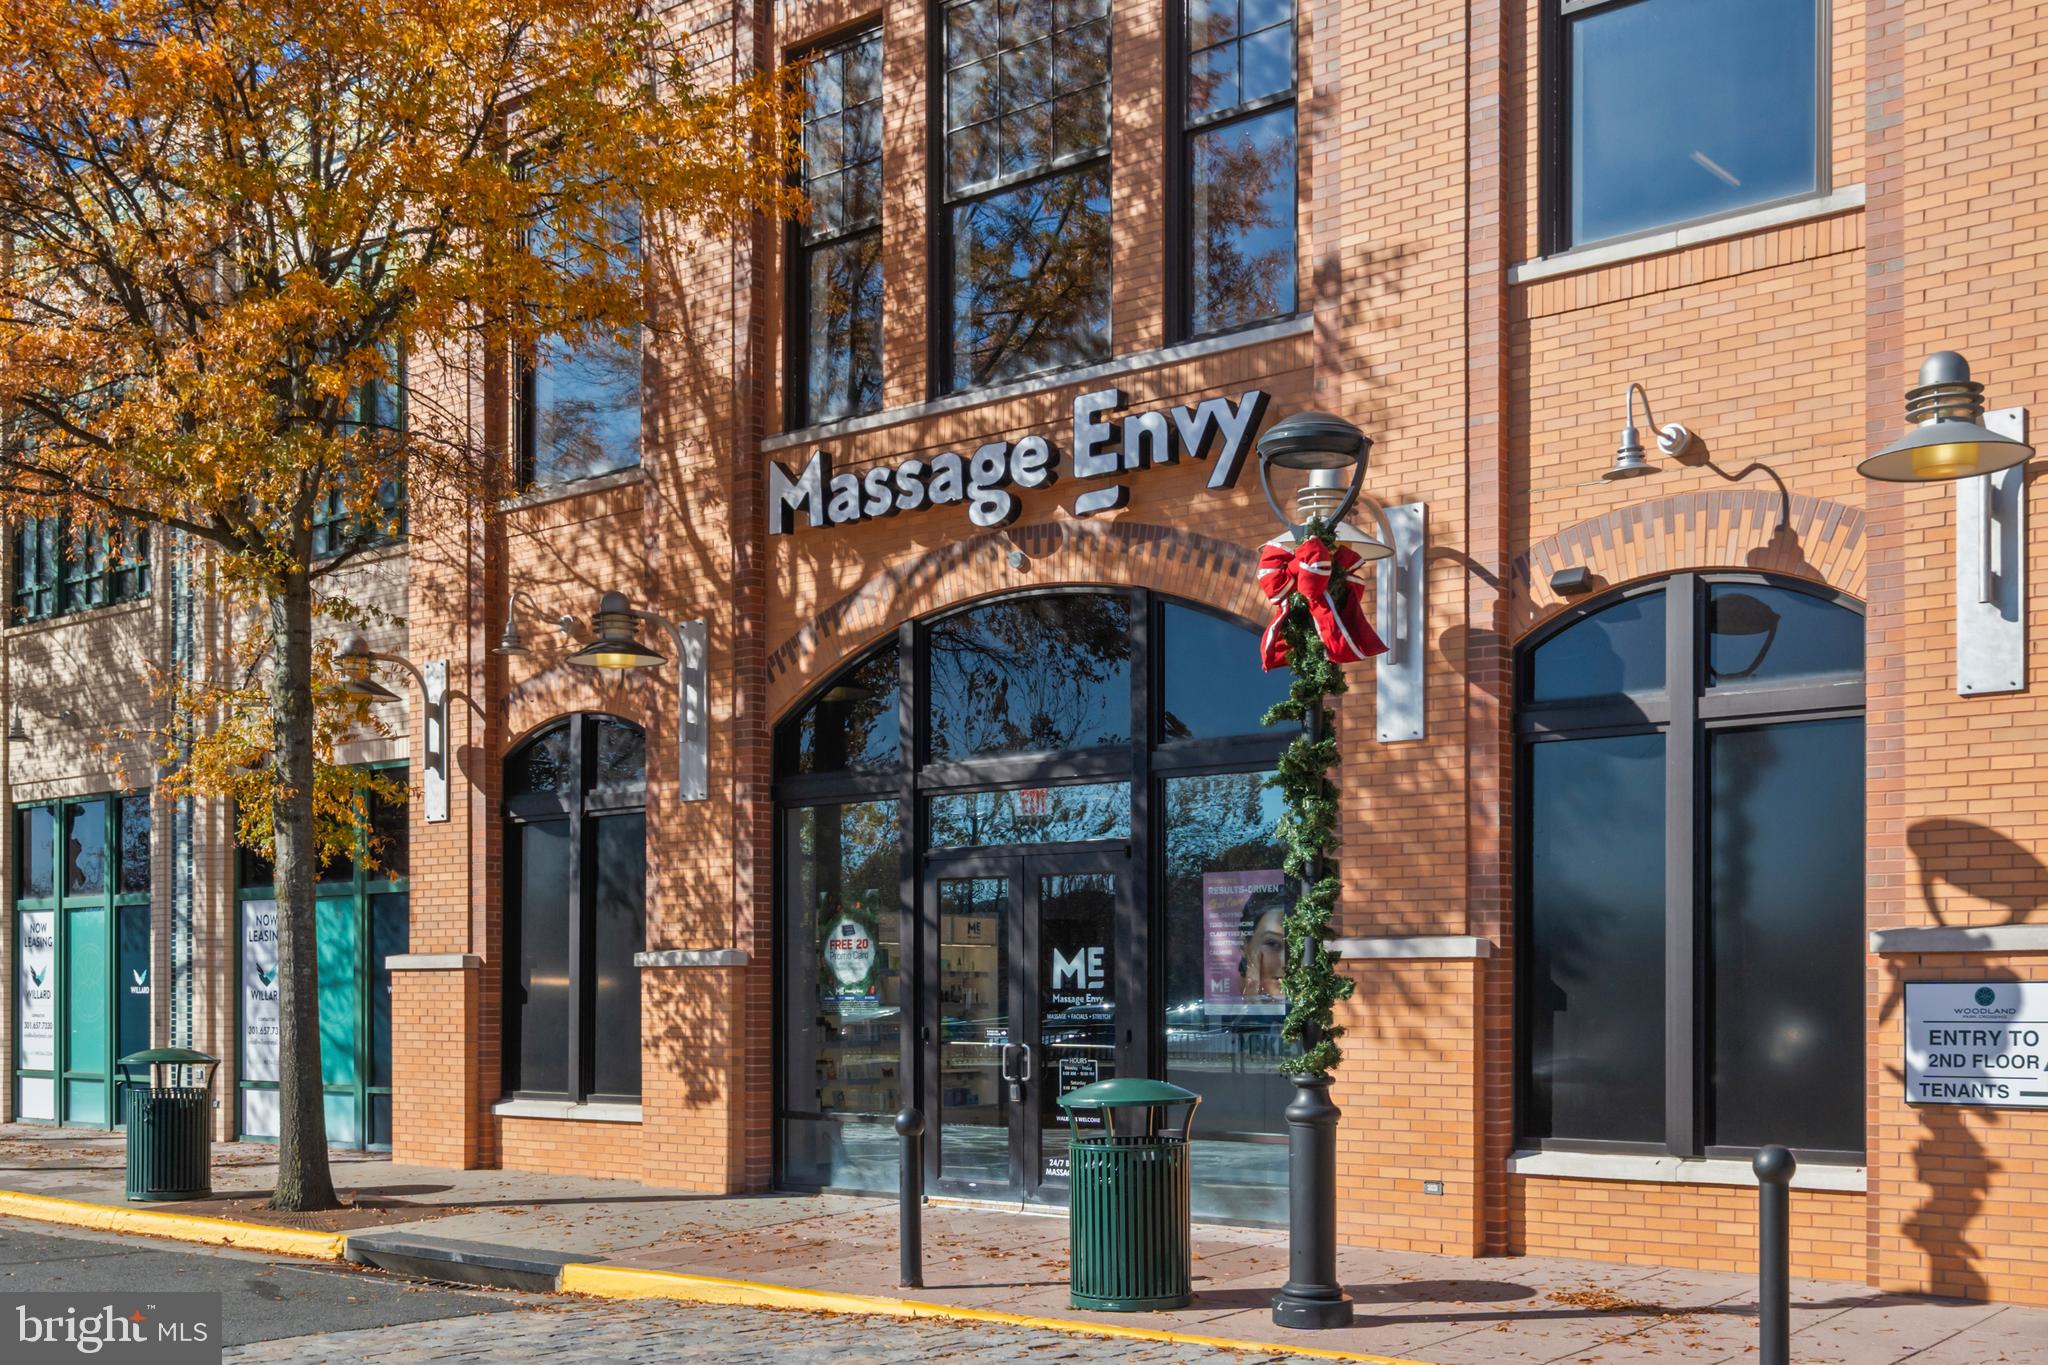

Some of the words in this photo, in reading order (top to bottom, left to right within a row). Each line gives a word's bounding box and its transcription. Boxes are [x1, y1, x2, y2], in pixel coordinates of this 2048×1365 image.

[769, 435, 1057, 534] Massage
[1073, 388, 1271, 515] Envy
[1208, 885, 1279, 894] RESULTS-DRIVEN
[256, 915, 278, 927] NOW
[30, 923, 47, 934] NOW
[967, 921, 981, 935] ME
[24, 936, 53, 948] LEASING
[248, 930, 279, 942] LEASIN
[829, 939, 853, 950] FREE
[856, 939, 869, 950] 20
[830, 952, 851, 960] Promo
[852, 951, 869, 960] Card
[1053, 947, 1105, 989] ME
[130, 986, 150, 994] WILLARD
[1210, 978, 1230, 993] ME
[26, 990, 51, 1000] WILLARD
[251, 990, 279, 1000] WILLAR
[1052, 993, 1084, 1006] Massage
[1085, 993, 1104, 1006] Envy
[1929, 1030, 2002, 1046] ENTRY
[2009, 1031, 2040, 1047] TO
[1928, 1054, 1966, 1068] 2ND
[1973, 1055, 2040, 1069] FLOOR
[1919, 1083, 2010, 1099] TENANTS
